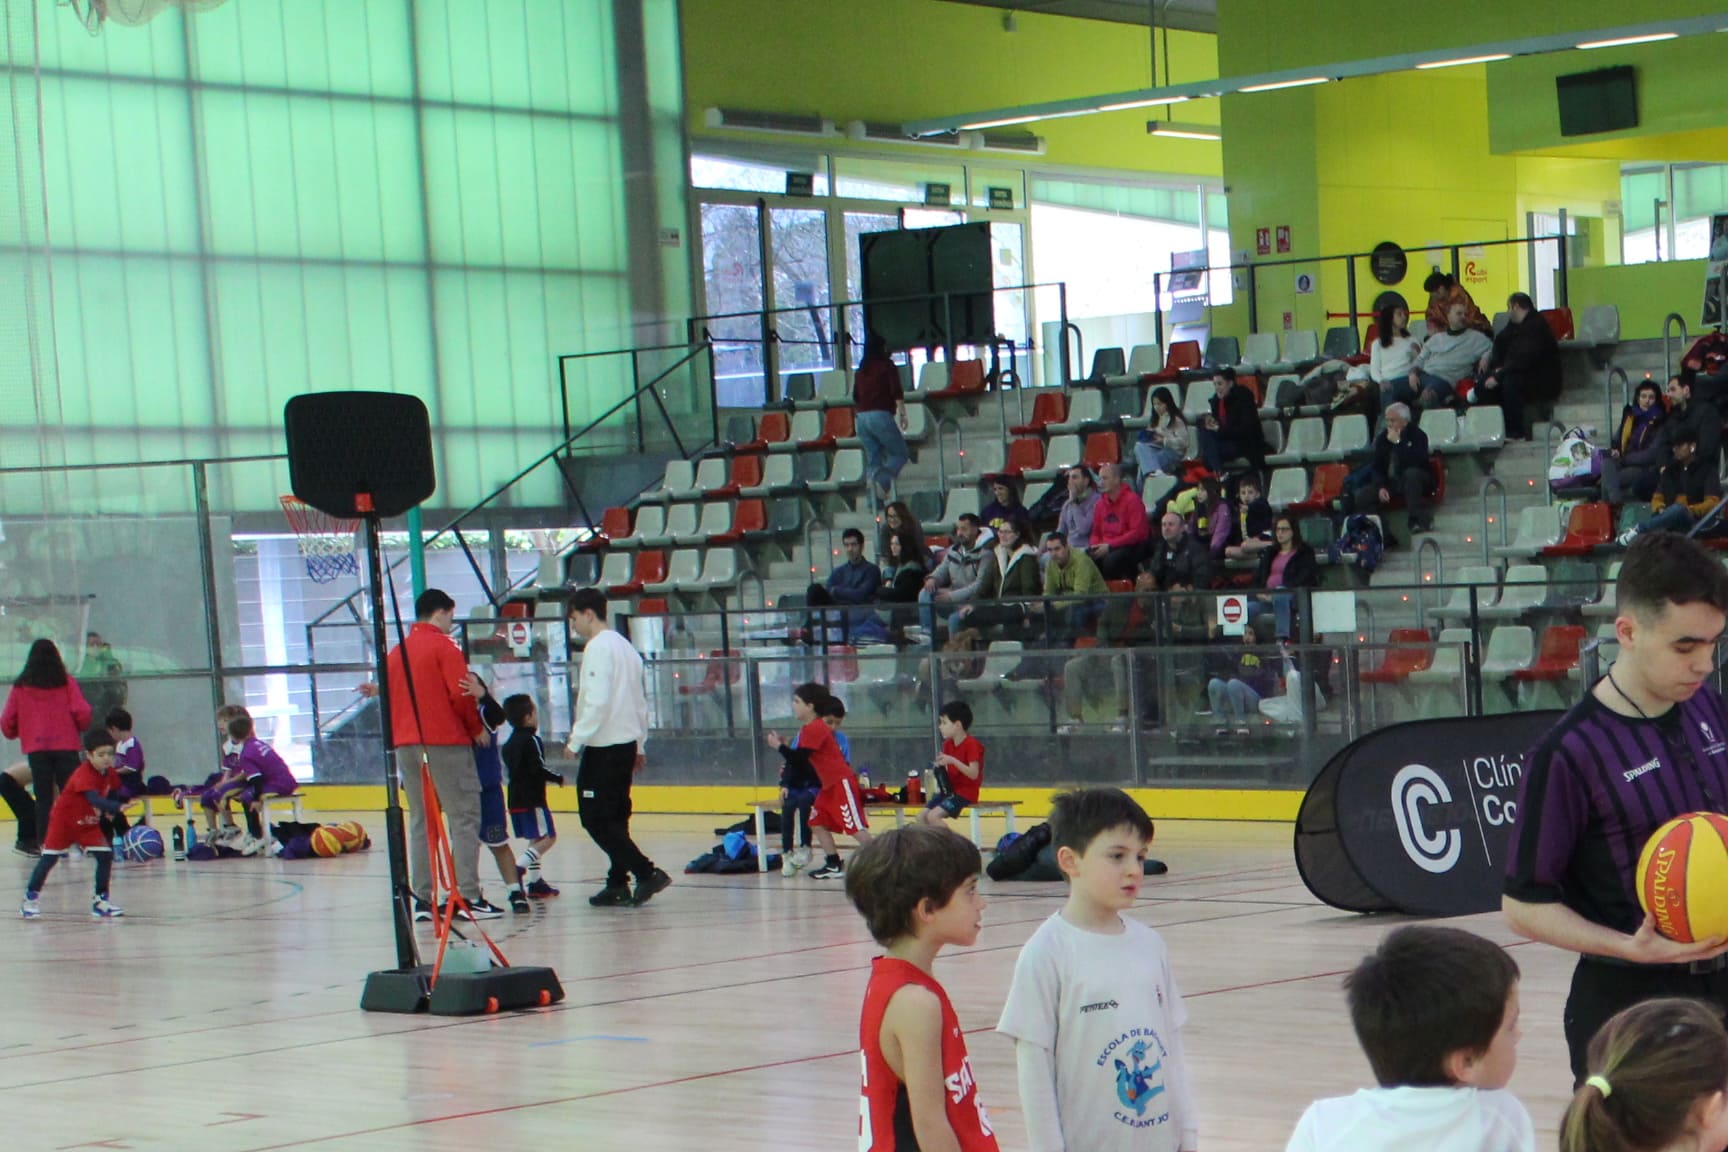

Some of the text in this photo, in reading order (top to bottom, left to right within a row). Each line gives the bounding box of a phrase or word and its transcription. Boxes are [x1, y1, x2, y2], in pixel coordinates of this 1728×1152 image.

[1473, 753, 1525, 790] Clín
[1622, 757, 1661, 783] SPALDING
[1096, 1033, 1129, 1067] ESCOLA
[1130, 1028, 1142, 1037] DE
